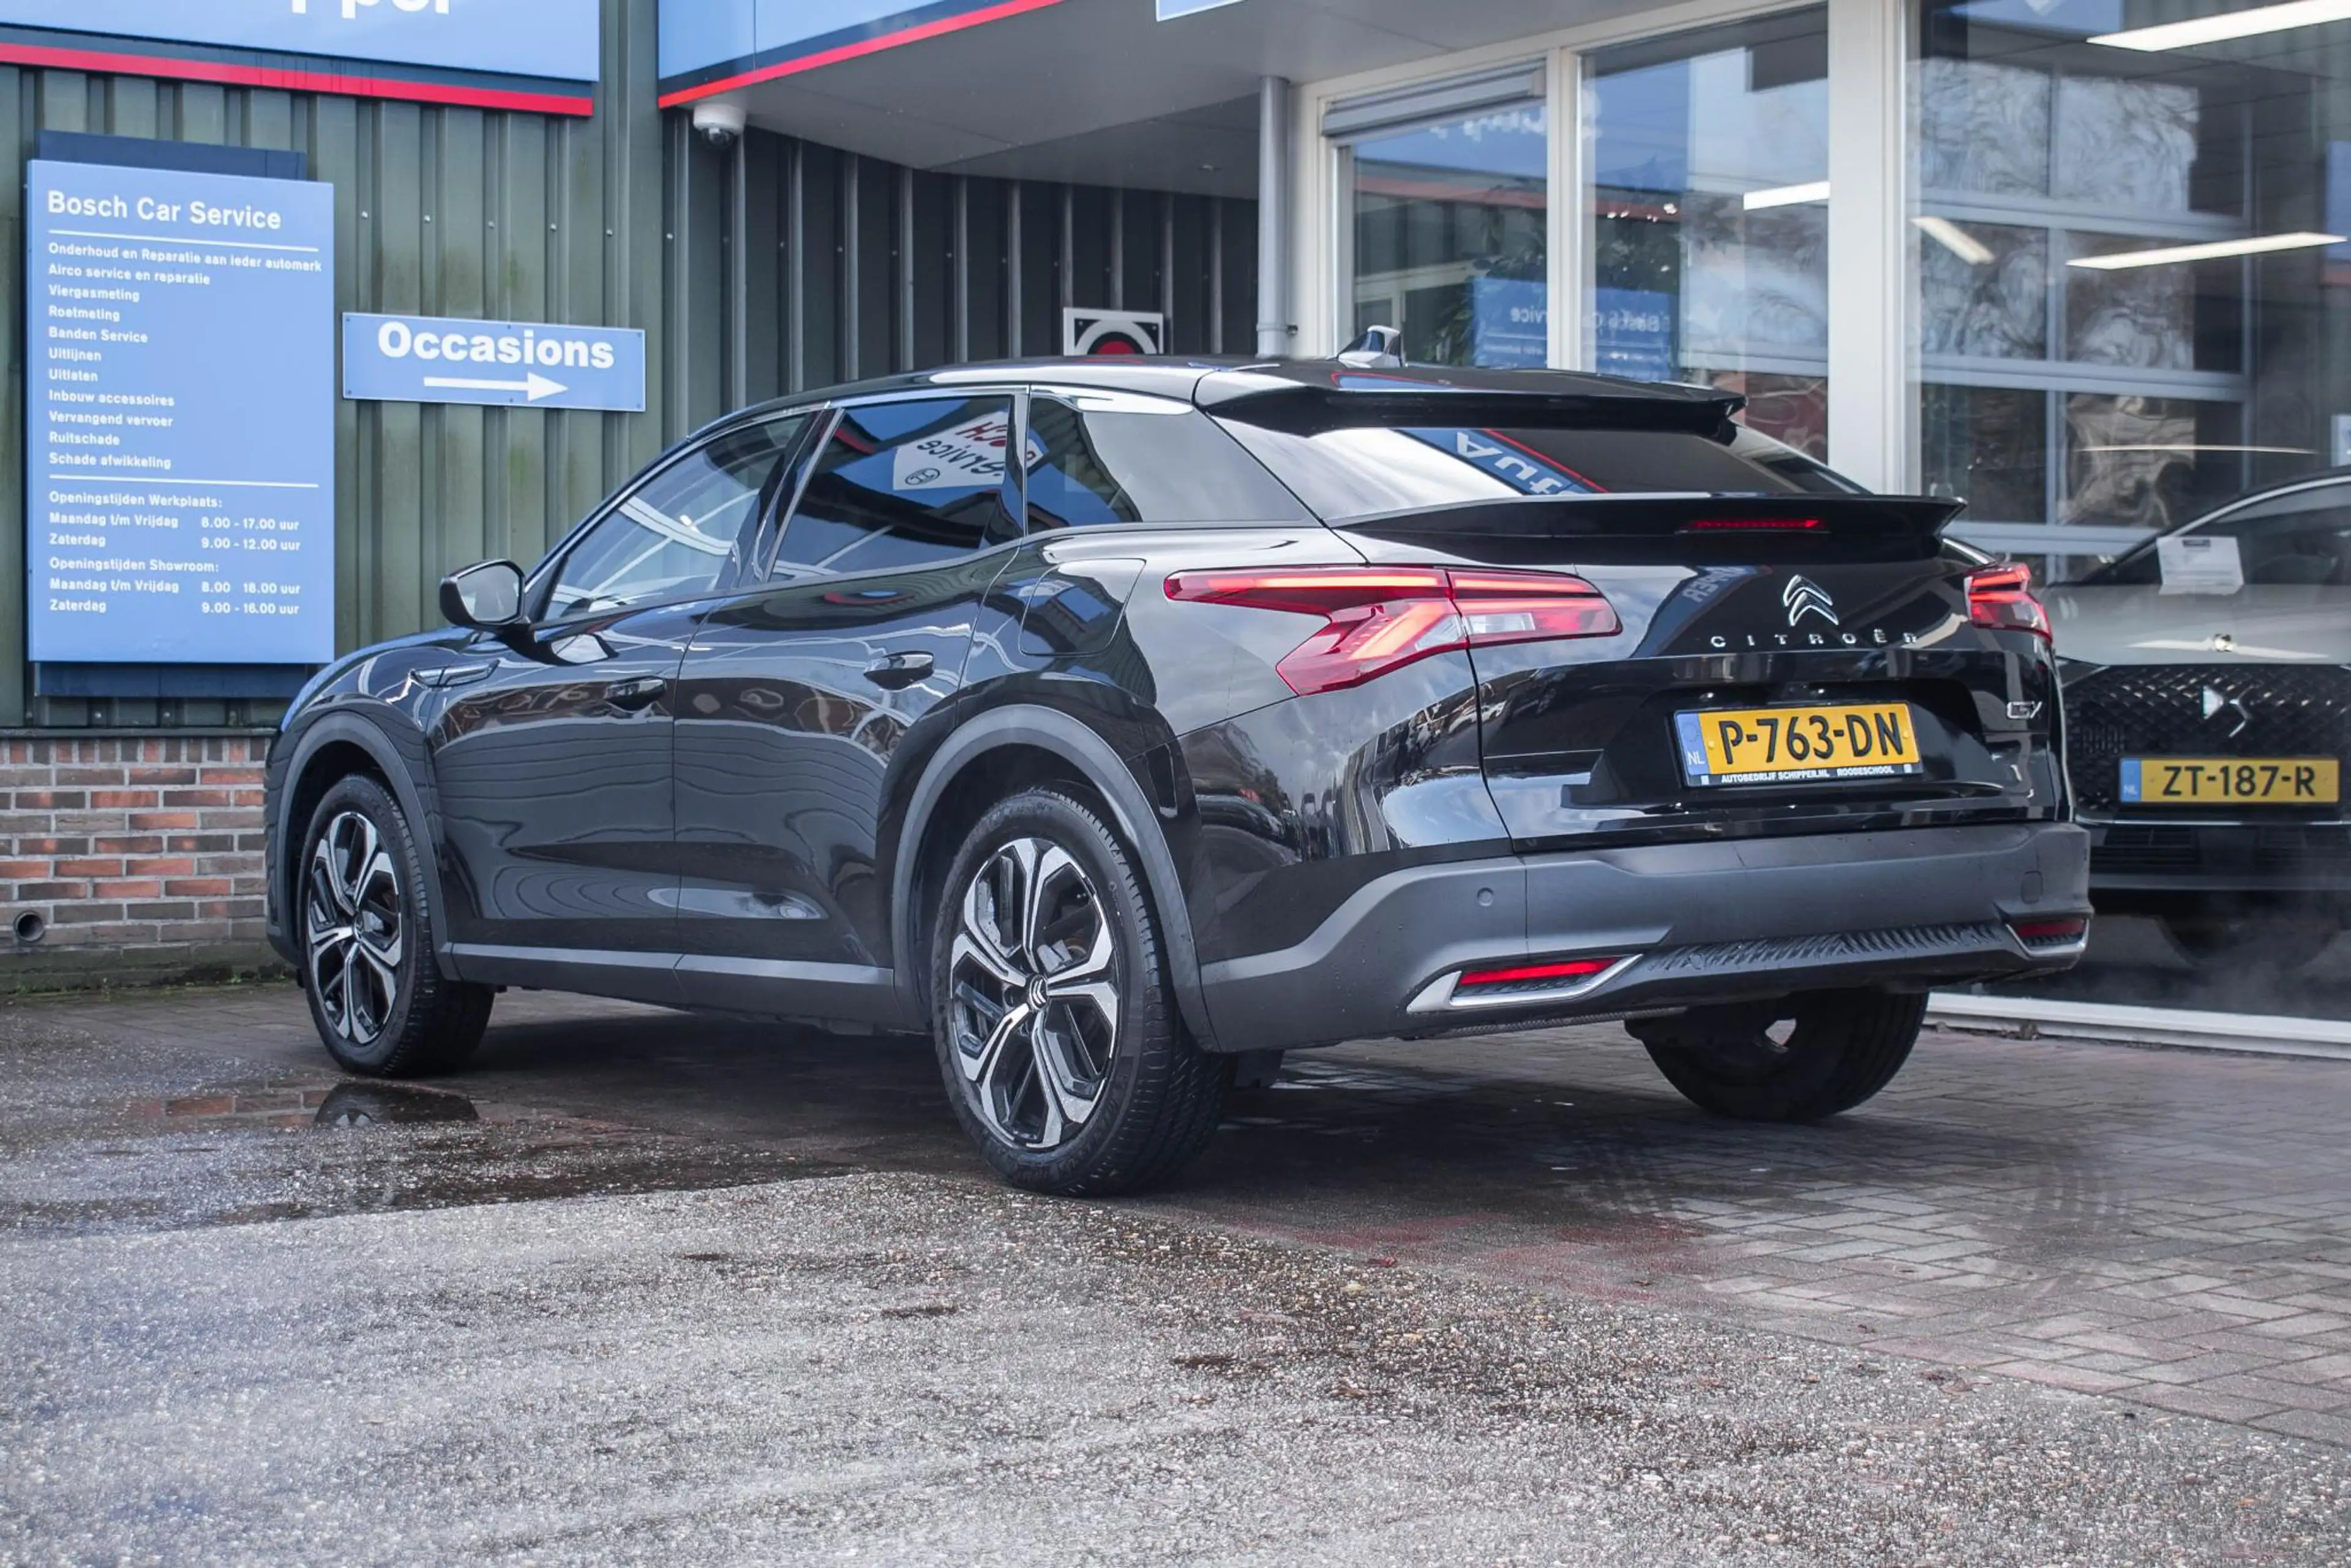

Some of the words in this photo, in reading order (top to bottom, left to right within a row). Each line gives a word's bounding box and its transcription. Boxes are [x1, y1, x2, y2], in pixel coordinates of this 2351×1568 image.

[48, 190, 127, 219] Bosch
[137, 197, 181, 222] Car
[190, 201, 281, 230] Service
[48, 242, 119, 258] Onderhoud
[121, 249, 138, 259] en
[141, 248, 201, 264] Reparatie
[204, 255, 227, 265] aan
[230, 255, 261, 268] ieder
[264, 258, 321, 271] automerk
[48, 263, 83, 277] Airco
[85, 267, 132, 280] service
[135, 271, 151, 281] en
[154, 272, 211, 285] reparatie
[48, 284, 140, 302] Viergasmeting
[48, 305, 120, 322] Roetmeting
[48, 326, 97, 340] Banden
[100, 329, 148, 343] Service
[377, 321, 615, 369] Occasions
[48, 347, 102, 361] Uitlijnen
[48, 368, 98, 381] Uitlaten
[49, 389, 96, 402] Inbouw
[98, 394, 174, 407] accessoires
[48, 410, 123, 426] Vervangend
[126, 416, 173, 427] vervoer
[49, 431, 120, 445] Ruitschade
[48, 452, 97, 465] Schade
[100, 454, 171, 470] afwikkeling
[49, 490, 145, 506] Openingstijden
[148, 494, 222, 508] Werkplaats:
[49, 512, 107, 527] Maandag
[110, 514, 130, 526] t/m
[134, 514, 179, 528] Vrijdag
[201, 516, 231, 528] 8.00
[242, 517, 276, 530] 17.00
[279, 521, 299, 530] uur
[49, 533, 106, 547] Zaterdag
[201, 537, 231, 549] 9.00
[243, 538, 277, 550] 12.00
[280, 541, 301, 550] uur
[49, 557, 146, 572] Openingstijden
[149, 558, 219, 572] Showroom:
[49, 577, 107, 592] Maandag
[110, 579, 131, 591] t/m
[134, 580, 179, 593] Vrijdag
[201, 581, 231, 593] 8.00
[280, 585, 301, 595] uur
[50, 599, 107, 613] Zaterdag
[201, 601, 231, 613] 9.00
[279, 606, 300, 615] uur
[1719, 712, 1903, 765] P-763-DN
[1687, 751, 1705, 766] NL
[1721, 772, 1776, 784] AUTOBEDRIJF
[2162, 765, 2315, 797] ZT-187-R
[2123, 784, 2138, 795] NL
